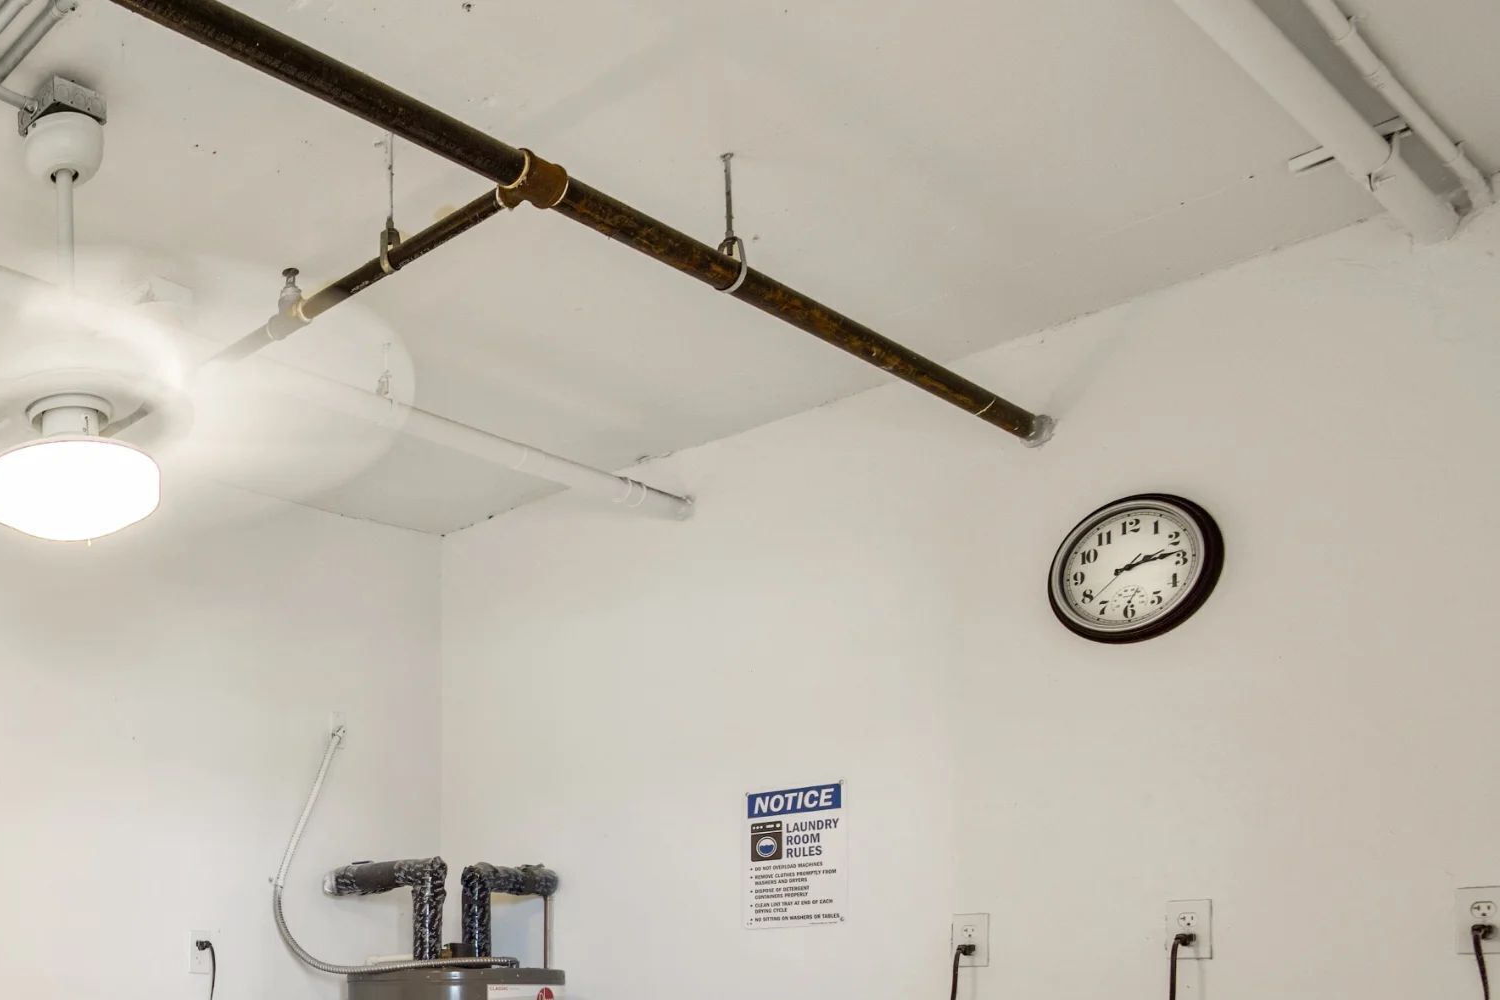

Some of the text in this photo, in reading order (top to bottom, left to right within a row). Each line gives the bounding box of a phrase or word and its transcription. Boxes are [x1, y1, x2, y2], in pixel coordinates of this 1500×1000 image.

[1121, 519, 1140, 535] 12
[1153, 520, 1160, 534] 1
[1098, 530, 1112, 546] 11
[1168, 531, 1181, 545] 2
[1081, 549, 1098, 565] 10
[1175, 551, 1188, 565] 3
[1073, 572, 1084, 585] 9
[1167, 573, 1180, 587] 4
[1082, 589, 1094, 604] 8
[1150, 590, 1162, 605] 5
[1099, 601, 1110, 615] 7
[1124, 604, 1135, 618] 6
[754, 788, 834, 815] NOTICE
[786, 818, 839, 834] LAUNDRY
[786, 833, 820, 846] ROOM
[786, 846, 822, 858] RULES
